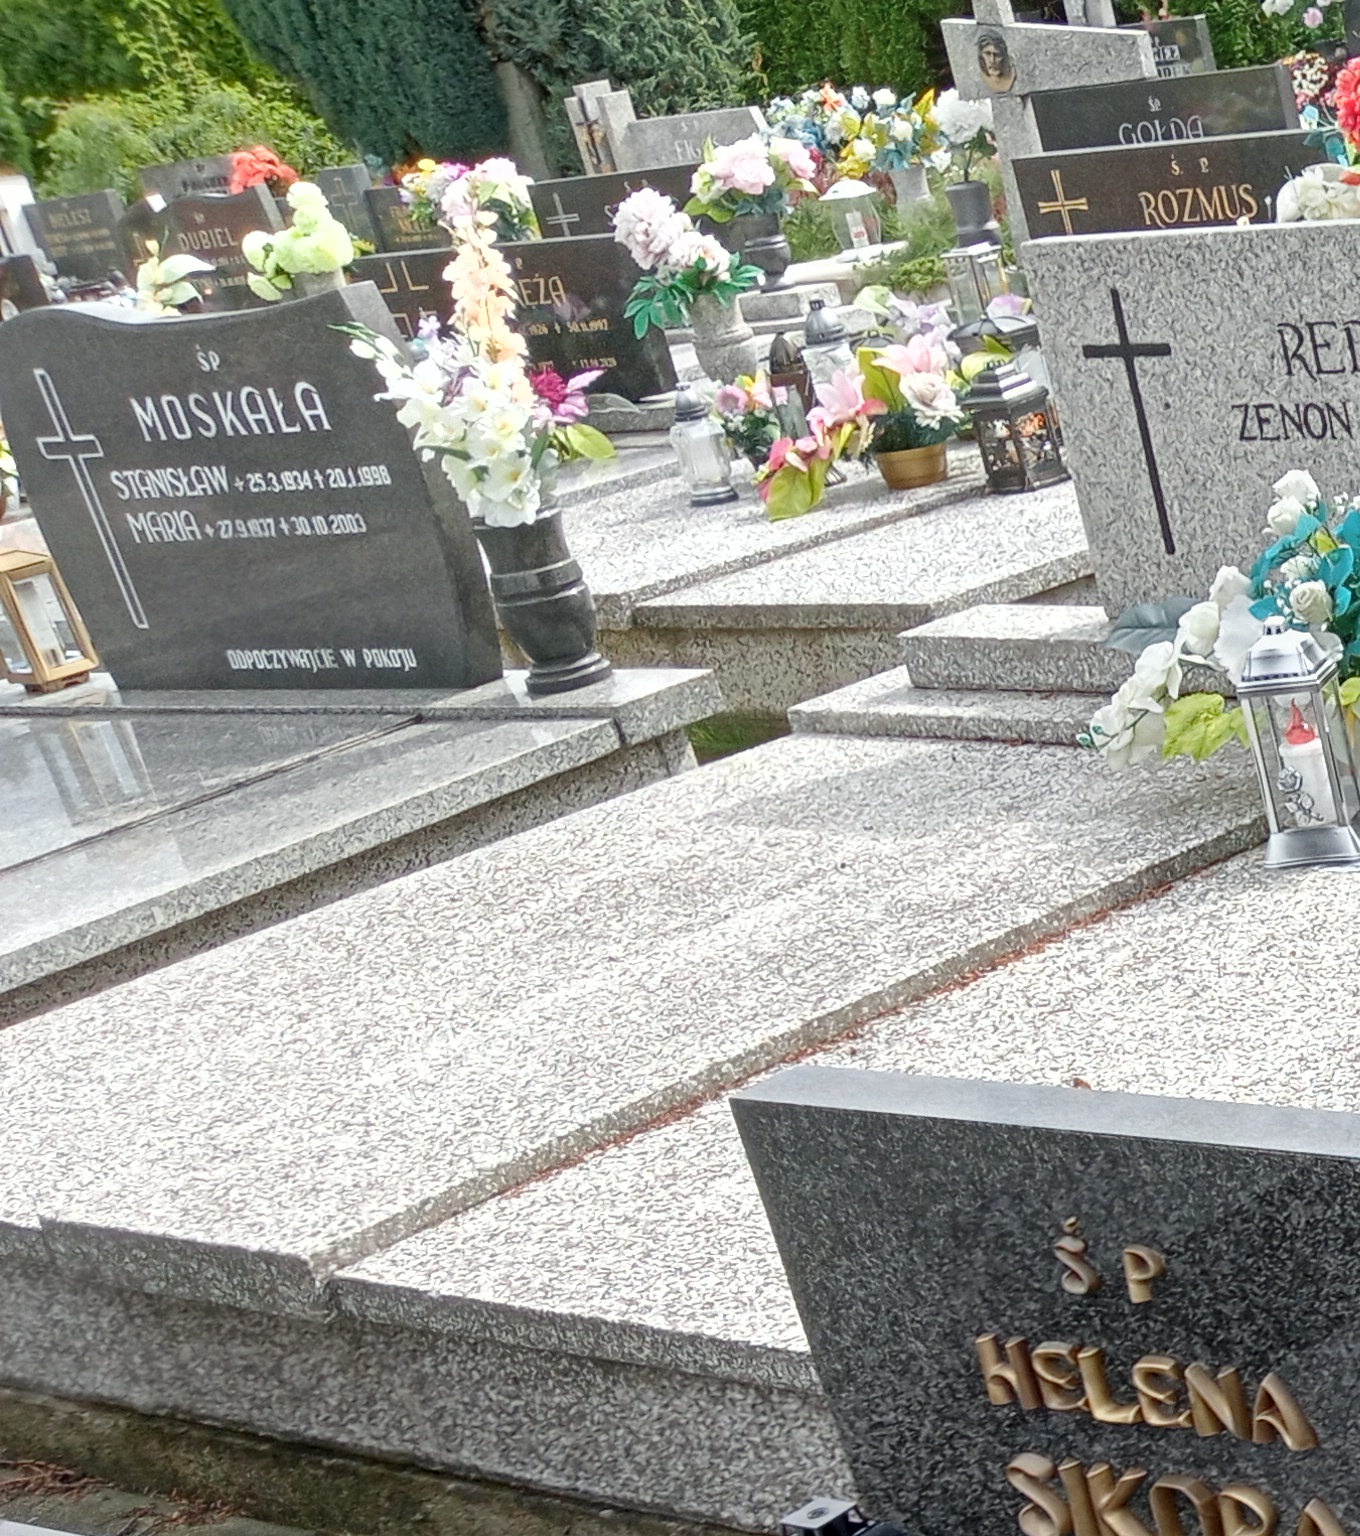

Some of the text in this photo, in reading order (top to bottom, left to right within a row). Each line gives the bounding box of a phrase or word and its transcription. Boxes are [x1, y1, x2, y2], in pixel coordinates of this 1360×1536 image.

[1138, 184, 1258, 228] ROZMUS
[178, 227, 239, 251] DUBIEL
[130, 381, 332, 442] MOSKAŁA
[1232, 402, 1353, 442] ZENON
[110, 465, 229, 500] STANISŁAW
[125, 509, 202, 544] MARIA
[227, 648, 418, 673] ODPOCZYWAJCIE W POKOJU
[1055, 1216, 1166, 1303] Ś P
[975, 1332, 1319, 1451] HELENA
